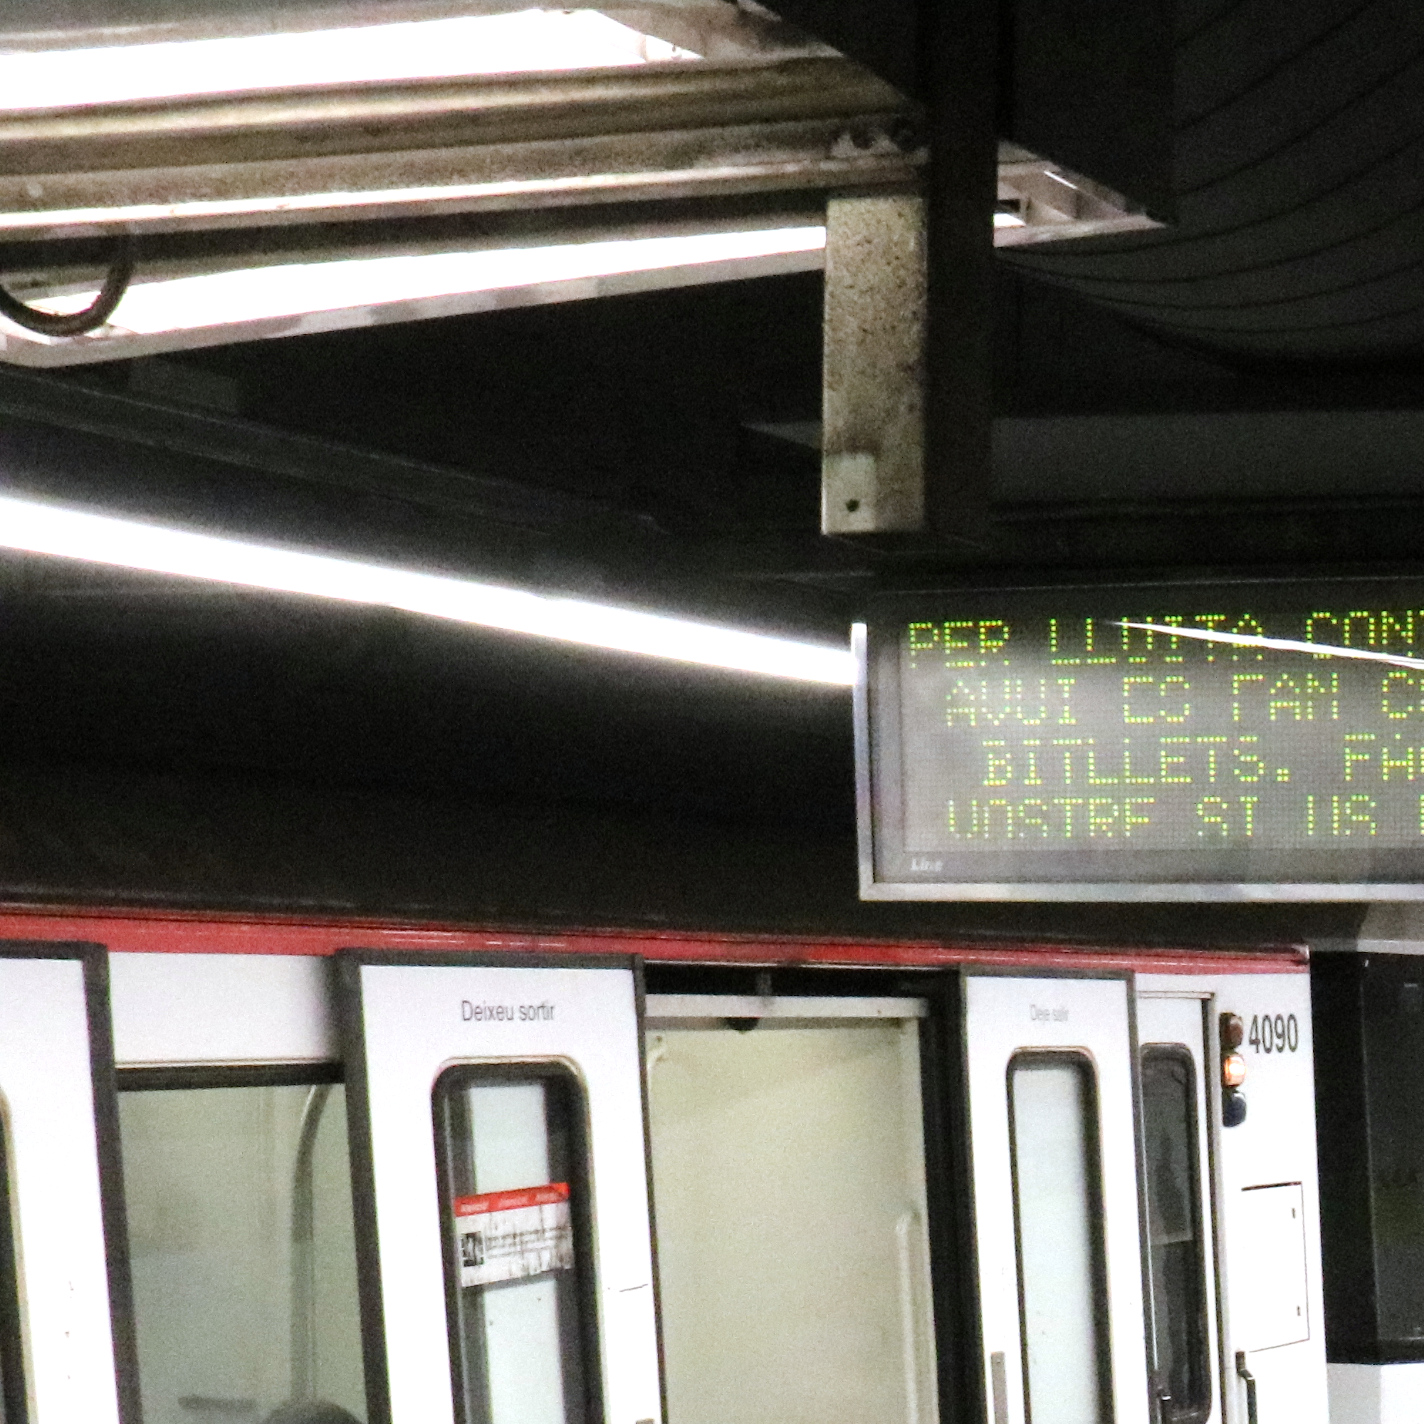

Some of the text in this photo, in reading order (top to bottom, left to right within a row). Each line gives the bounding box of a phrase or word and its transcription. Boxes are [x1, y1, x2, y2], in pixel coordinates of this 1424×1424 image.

[908, 619, 1011, 669] PER
[462, 999, 556, 1022] Deixeu sortir
[1248, 1012, 1299, 1054] 4090
